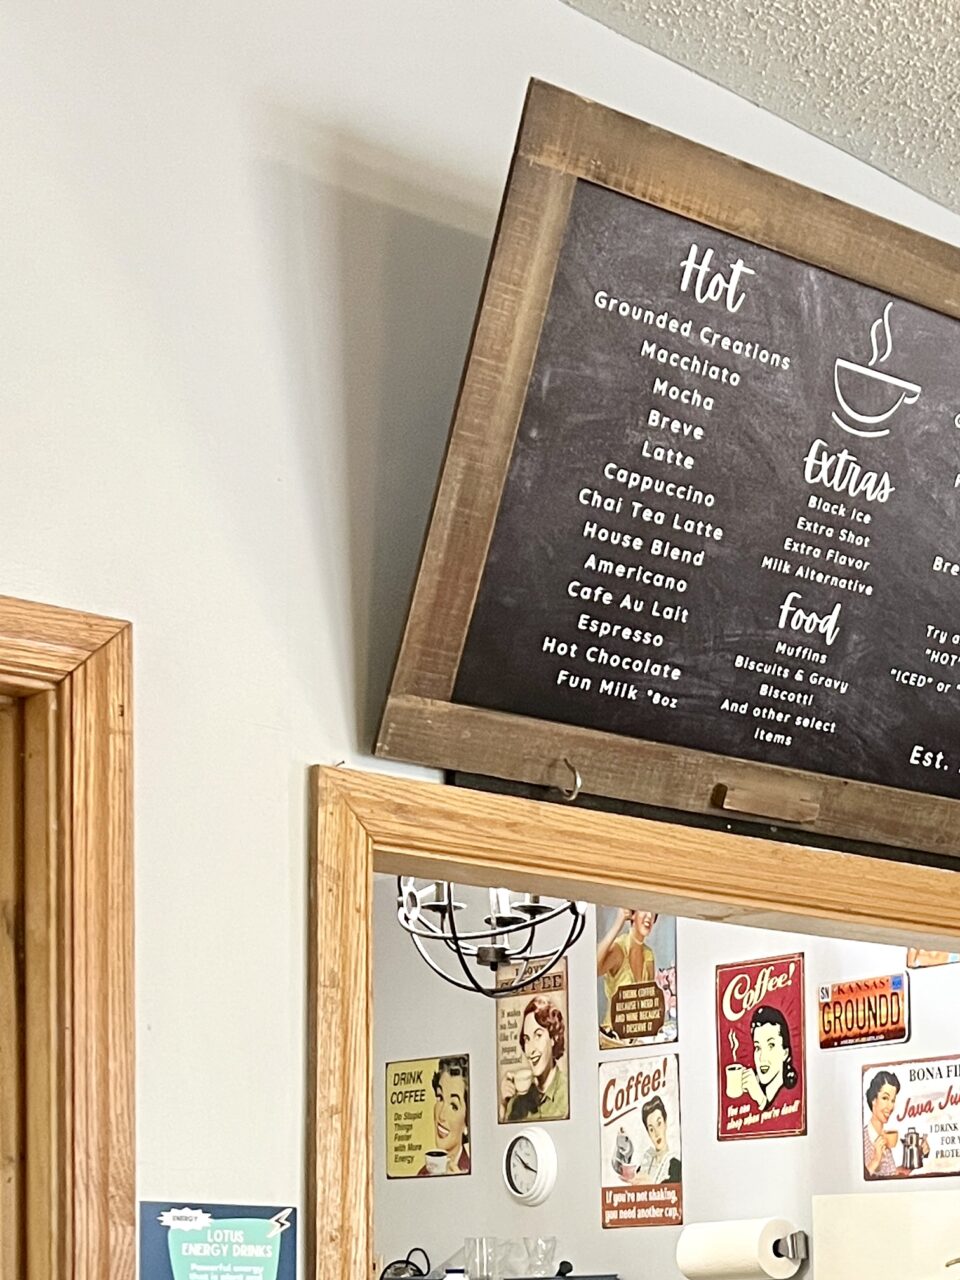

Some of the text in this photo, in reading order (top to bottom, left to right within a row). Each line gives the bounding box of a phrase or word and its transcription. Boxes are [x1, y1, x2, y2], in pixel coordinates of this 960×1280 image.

[679, 243, 756, 314] Hot
[594, 290, 791, 371] Grounded Creations
[640, 339, 741, 387] Macchiato
[652, 377, 715, 411] Mocha
[647, 409, 704, 440] Breve
[641, 440, 695, 470] Latte
[604, 462, 715, 507] Cappuccino
[803, 438, 896, 503] Extras
[578, 488, 723, 541] Chai Tea Latte
[808, 495, 872, 525] Black Ice
[583, 521, 705, 566] House Blend
[796, 516, 870, 548] Extra Shot
[783, 537, 871, 571] Extra Flavor
[584, 554, 687, 593] Americano
[761, 555, 873, 596] Milk Alternative
[567, 580, 689, 623] Cafe Au Lait
[577, 613, 664, 647] Espresso
[926, 624, 948, 644] Try
[542, 636, 681, 681] Hot Chocolate
[775, 641, 827, 664] Muffins
[557, 669, 592, 691] Fun
[599, 679, 638, 700] Milk
[734, 655, 849, 694] Biscuits & Gravy
[890, 668, 934, 688] "ICED"
[936, 682, 952, 693] or
[759, 683, 814, 706] Biscotti
[720, 698, 836, 733] And other select
[909, 745, 948, 771] Est.
[723, 962, 796, 1022] Coffee!
[820, 986, 830, 1000] SN
[837, 979, 886, 996] KANSAS
[822, 992, 900, 1034] GROUNDD
[393, 1070, 424, 1087] DRINK
[602, 1057, 668, 1119] Coffee!
[909, 1066, 943, 1082] BONA
[390, 1089, 426, 1104] COFFEE
[897, 1098, 934, 1121] Java
[403, 1111, 423, 1122] Stupid
[934, 1122, 958, 1133] DRINK
[407, 1143, 422, 1151] More
[940, 1136, 955, 1145] FOR
[394, 1154, 415, 1164] Energy
[605, 1191, 613, 1204] If
[613, 1189, 635, 1208] you're
[636, 1189, 648, 1202] not
[605, 1208, 618, 1222] you
[619, 1207, 636, 1220] need
[637, 1206, 663, 1219] another
[182, 1243, 272, 1257] ENERGY DRINKS
[207, 1229, 244, 1243] LOTUS
